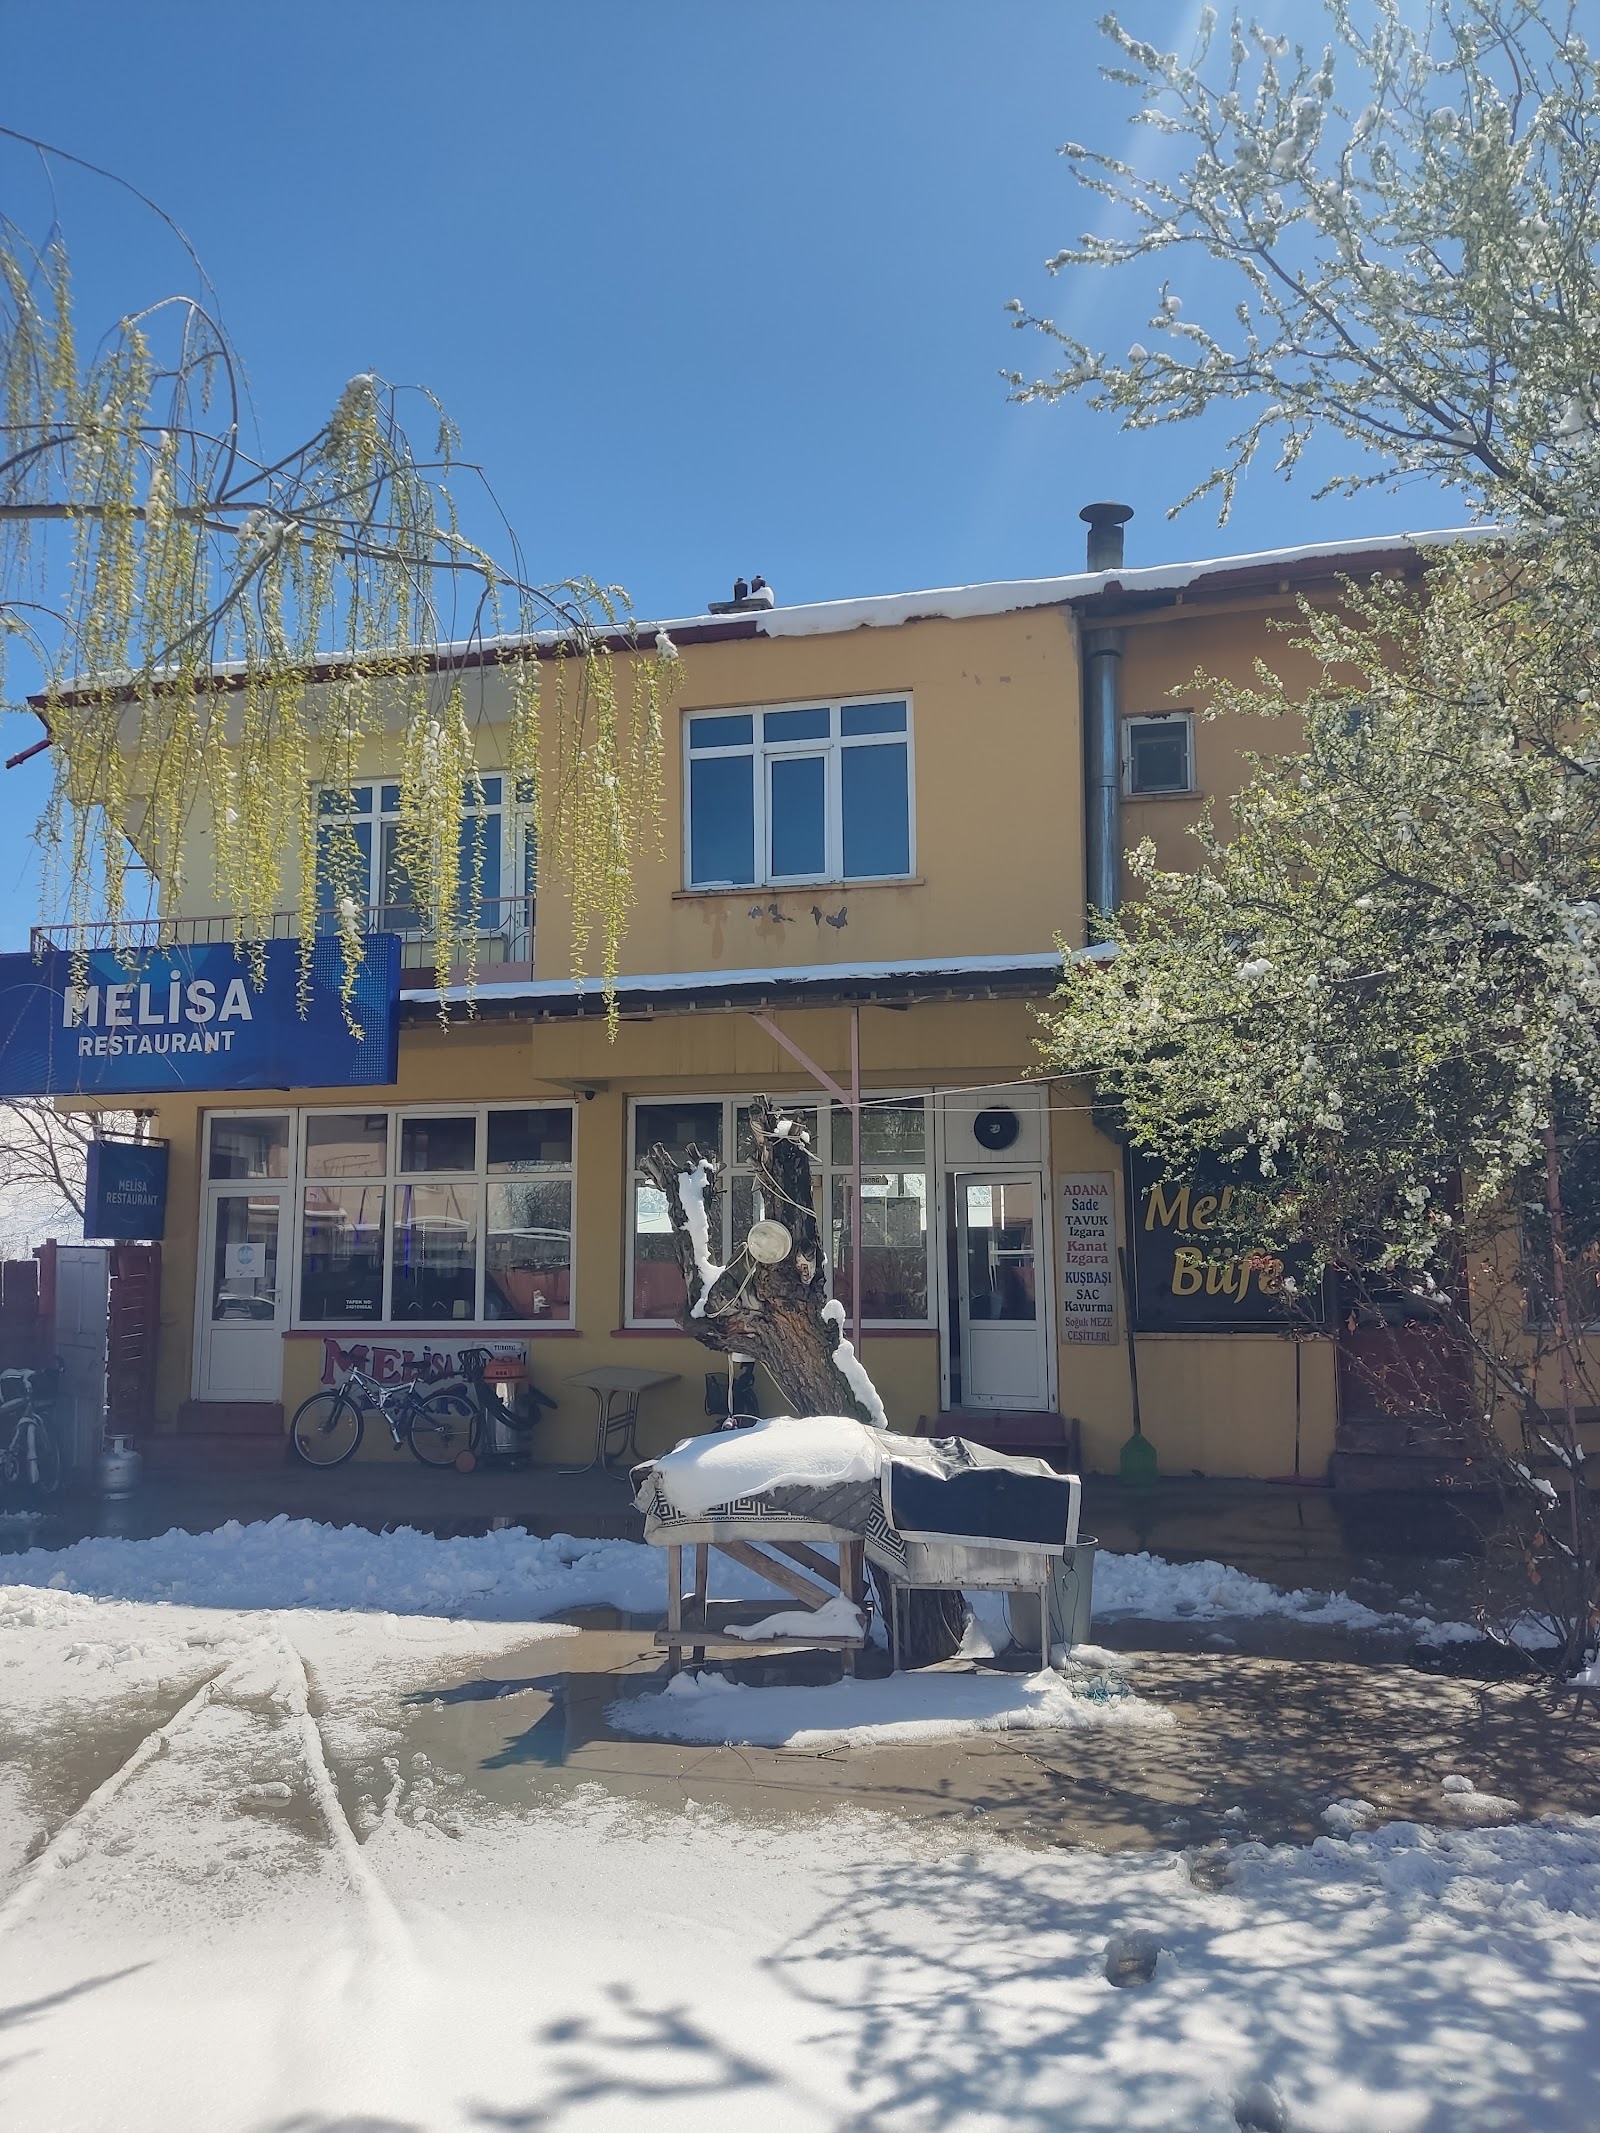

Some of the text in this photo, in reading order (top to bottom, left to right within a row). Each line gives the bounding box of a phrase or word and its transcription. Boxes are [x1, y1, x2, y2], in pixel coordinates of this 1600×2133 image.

[62, 969, 253, 1028] MELİSA
[78, 1030, 235, 1057] RESTAURANT
[118, 1178, 148, 1192] MELİSA
[1063, 1184, 1108, 1196] ADANA
[106, 1191, 158, 1206] RESTAURANT
[1071, 1198, 1099, 1211] Sade
[1065, 1215, 1108, 1226] TAVUK
[1069, 1227, 1105, 1239] Izgara
[1067, 1241, 1108, 1252] Kanat
[1066, 1253, 1109, 1266] Izgara
[1065, 1271, 1112, 1286] KUŞBAŞI
[1076, 1289, 1100, 1300] SAC
[1064, 1301, 1113, 1313] Kavurma
[1065, 1316, 1113, 1329] Soğuk MEZE
[1067, 1329, 1110, 1343] ÇEŞİTLERİ
